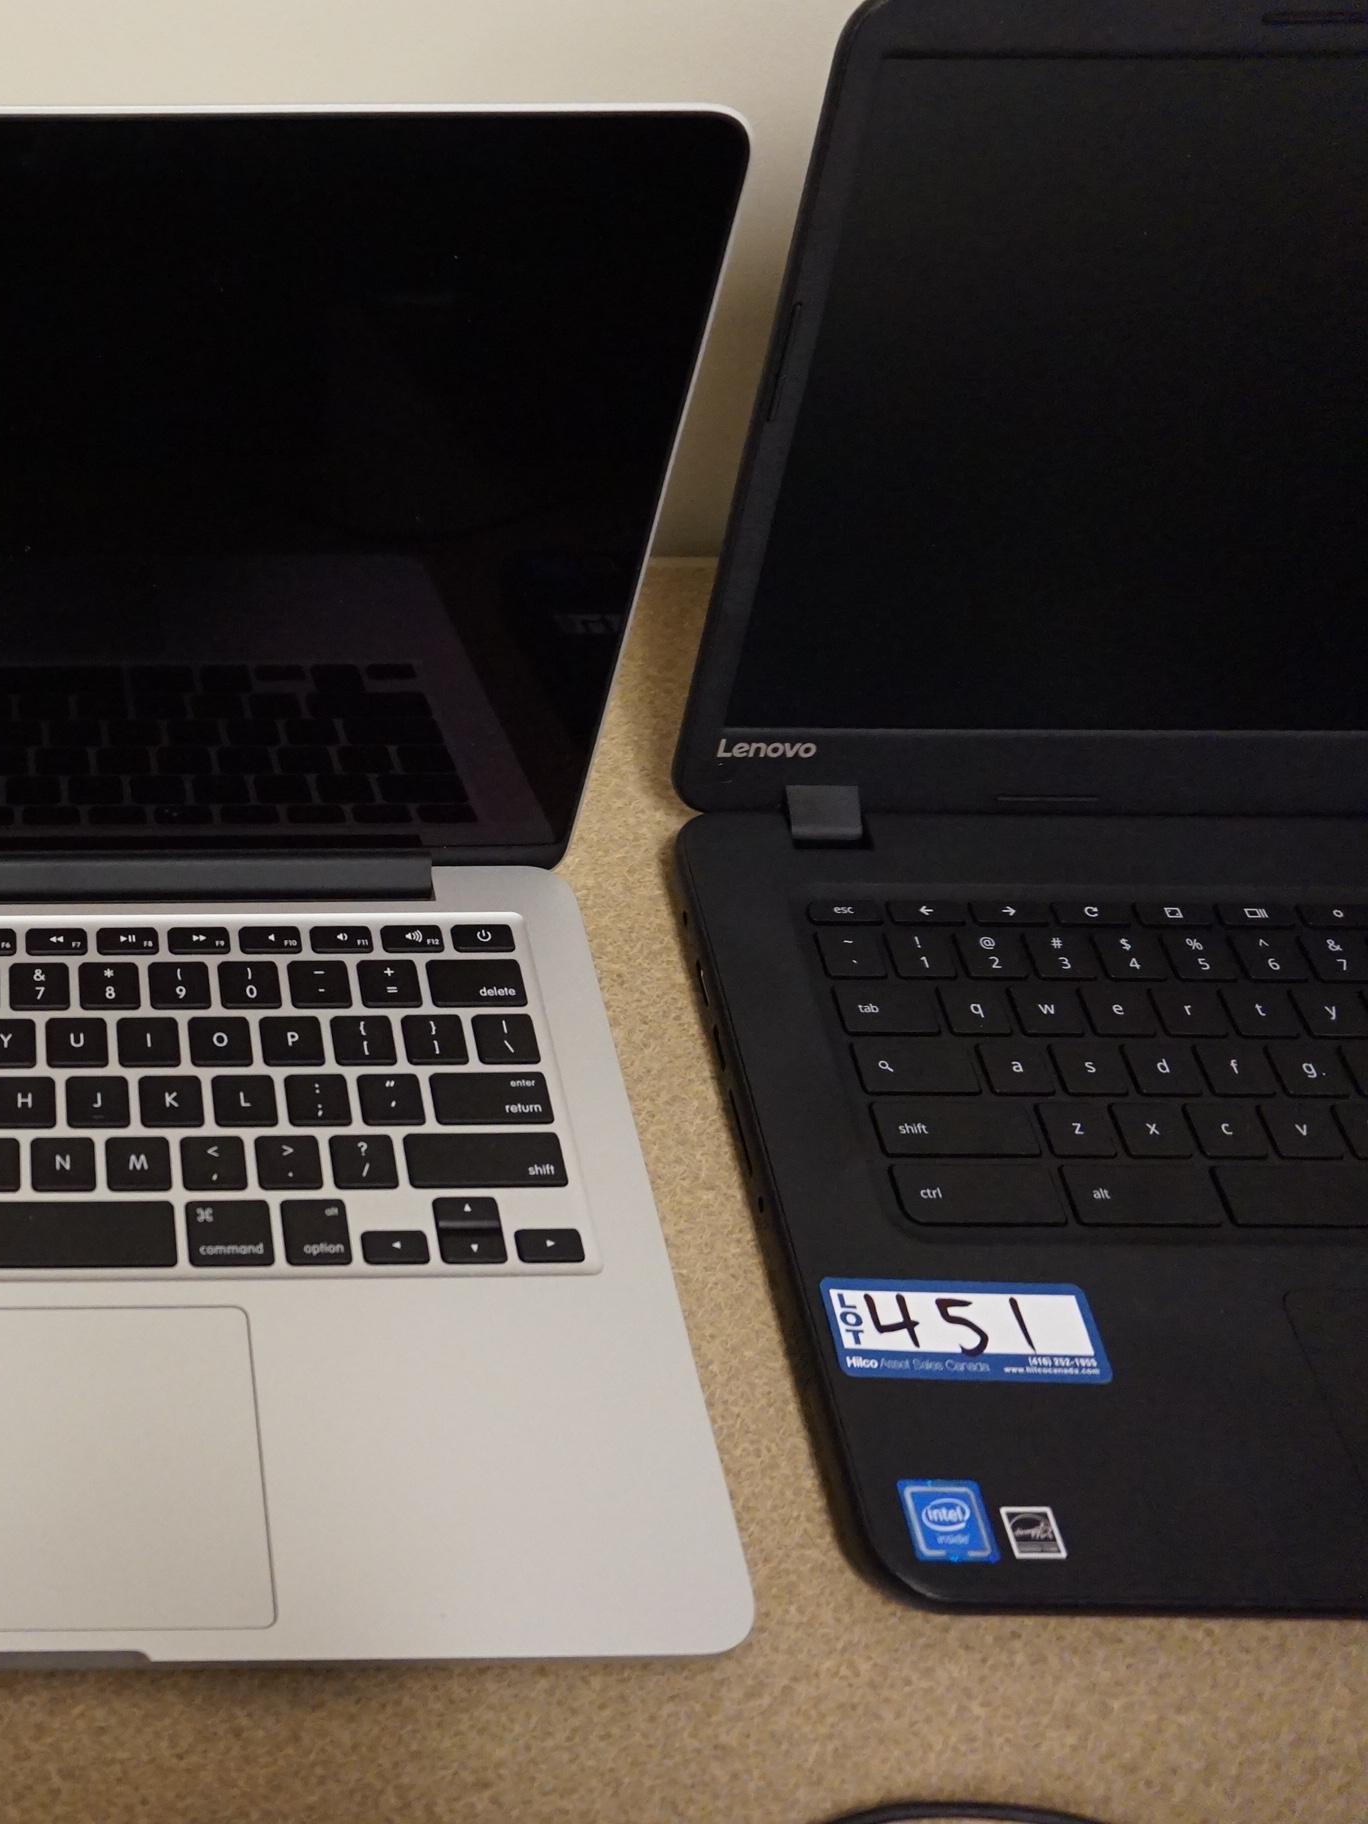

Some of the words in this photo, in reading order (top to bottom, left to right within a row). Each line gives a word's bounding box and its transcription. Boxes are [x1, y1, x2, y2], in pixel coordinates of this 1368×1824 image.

[716, 738, 817, 758] Lenovo
[833, 906, 855, 914] esc
[979, 936, 995, 950] @
[1051, 936, 1063, 950] #
[1120, 937, 1131, 952] $
[1186, 937, 1203, 951] %
[1326, 938, 1343, 952] &
[920, 955, 930, 969] 1
[989, 955, 1002, 969] 2
[1058, 956, 1071, 970] 3
[1128, 957, 1141, 970] 4
[1198, 957, 1210, 971] 5
[1268, 957, 1280, 971] 6
[1336, 958, 1347, 972] 7
[34, 969, 45, 981] &
[384, 968, 394, 976] +
[35, 987, 45, 999] 7
[106, 986, 115, 999] 8
[176, 986, 186, 998] 9
[246, 985, 257, 998] 0
[480, 987, 515, 996] delete
[858, 1002, 880, 1014] tab
[970, 1003, 984, 1019] q
[1038, 1003, 1055, 1015] w
[1112, 1003, 1124, 1016] e
[1183, 1004, 1192, 1016] r
[1255, 1003, 1266, 1017] t
[1324, 1005, 1337, 1021] y
[0, 1034, 12, 1048] Y
[70, 1033, 84, 1047] U
[213, 1032, 228, 1046] O
[287, 1032, 298, 1046] P
[504, 1040, 514, 1052] \
[1011, 1060, 1024, 1073] a
[1085, 1061, 1096, 1074] s
[1157, 1057, 1170, 1074] d
[1230, 1058, 1239, 1075] f
[1302, 1062, 1317, 1079] g
[18, 1093, 32, 1108] H
[93, 1093, 101, 1107] J
[165, 1092, 178, 1107] K
[240, 1092, 250, 1106] L
[505, 1104, 542, 1113] return
[898, 1122, 929, 1135] shift
[1072, 1123, 1084, 1135] z
[1146, 1123, 1160, 1135] x
[1221, 1123, 1233, 1136] c
[1295, 1124, 1307, 1136] v
[207, 1146, 219, 1157] <
[282, 1145, 293, 1155] >
[358, 1142, 367, 1156] ?
[56, 1155, 70, 1170] N
[129, 1154, 148, 1170] M
[529, 1164, 554, 1175] shift
[920, 1186, 943, 1200] ctrl
[1093, 1187, 1112, 1200] alt
[325, 1207, 338, 1216] alt
[199, 1243, 264, 1255] command
[304, 1243, 344, 1255] option
[837, 1294, 864, 1345] LOT
[864, 1293, 1037, 1357] 451
[846, 1356, 878, 1369] Hilco
[927, 1506, 963, 1522] intel
